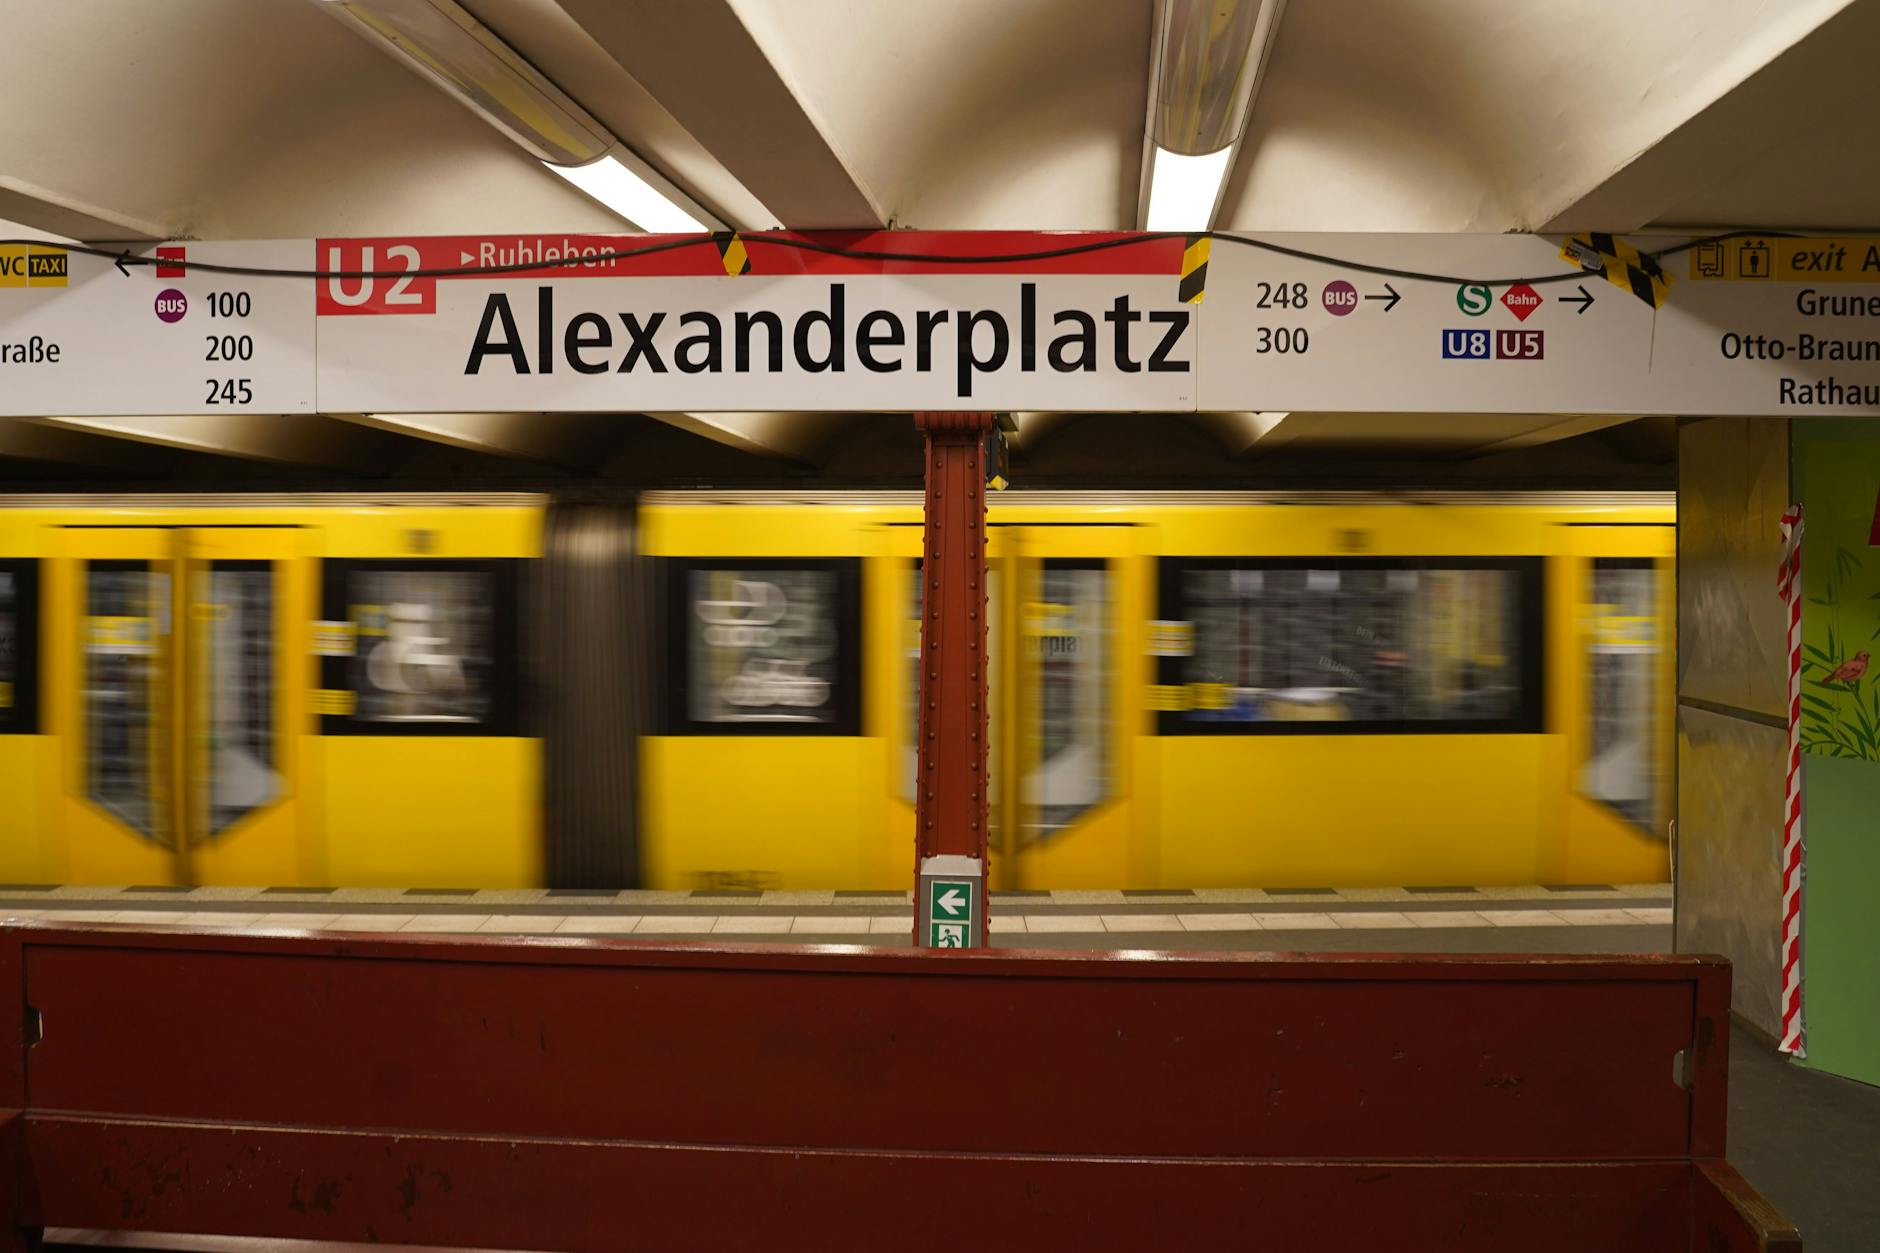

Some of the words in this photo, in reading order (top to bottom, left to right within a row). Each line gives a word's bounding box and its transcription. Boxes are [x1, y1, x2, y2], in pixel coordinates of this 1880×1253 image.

[31, 258, 66, 273] TAXI
[480, 239, 616, 268] Ruhleben
[1791, 243, 1848, 271] exit
[328, 245, 423, 306] U2
[158, 299, 186, 313] BUS
[206, 292, 251, 318] 100
[1256, 282, 1308, 309] 248
[1325, 291, 1355, 305] BUS
[1463, 285, 1487, 314] S
[1507, 293, 1537, 305] Bahn
[1796, 289, 1880, 317] Grune
[2, 335, 61, 363] raße
[205, 335, 253, 361] 200
[464, 283, 1190, 397] Alexanderplatz
[1256, 327, 1309, 354] 300
[1448, 332, 1486, 356] U8
[1502, 333, 1539, 357] U5
[1721, 332, 1880, 361] Otto-Braun
[205, 379, 253, 405] 245
[1780, 376, 1880, 405] Rathau
